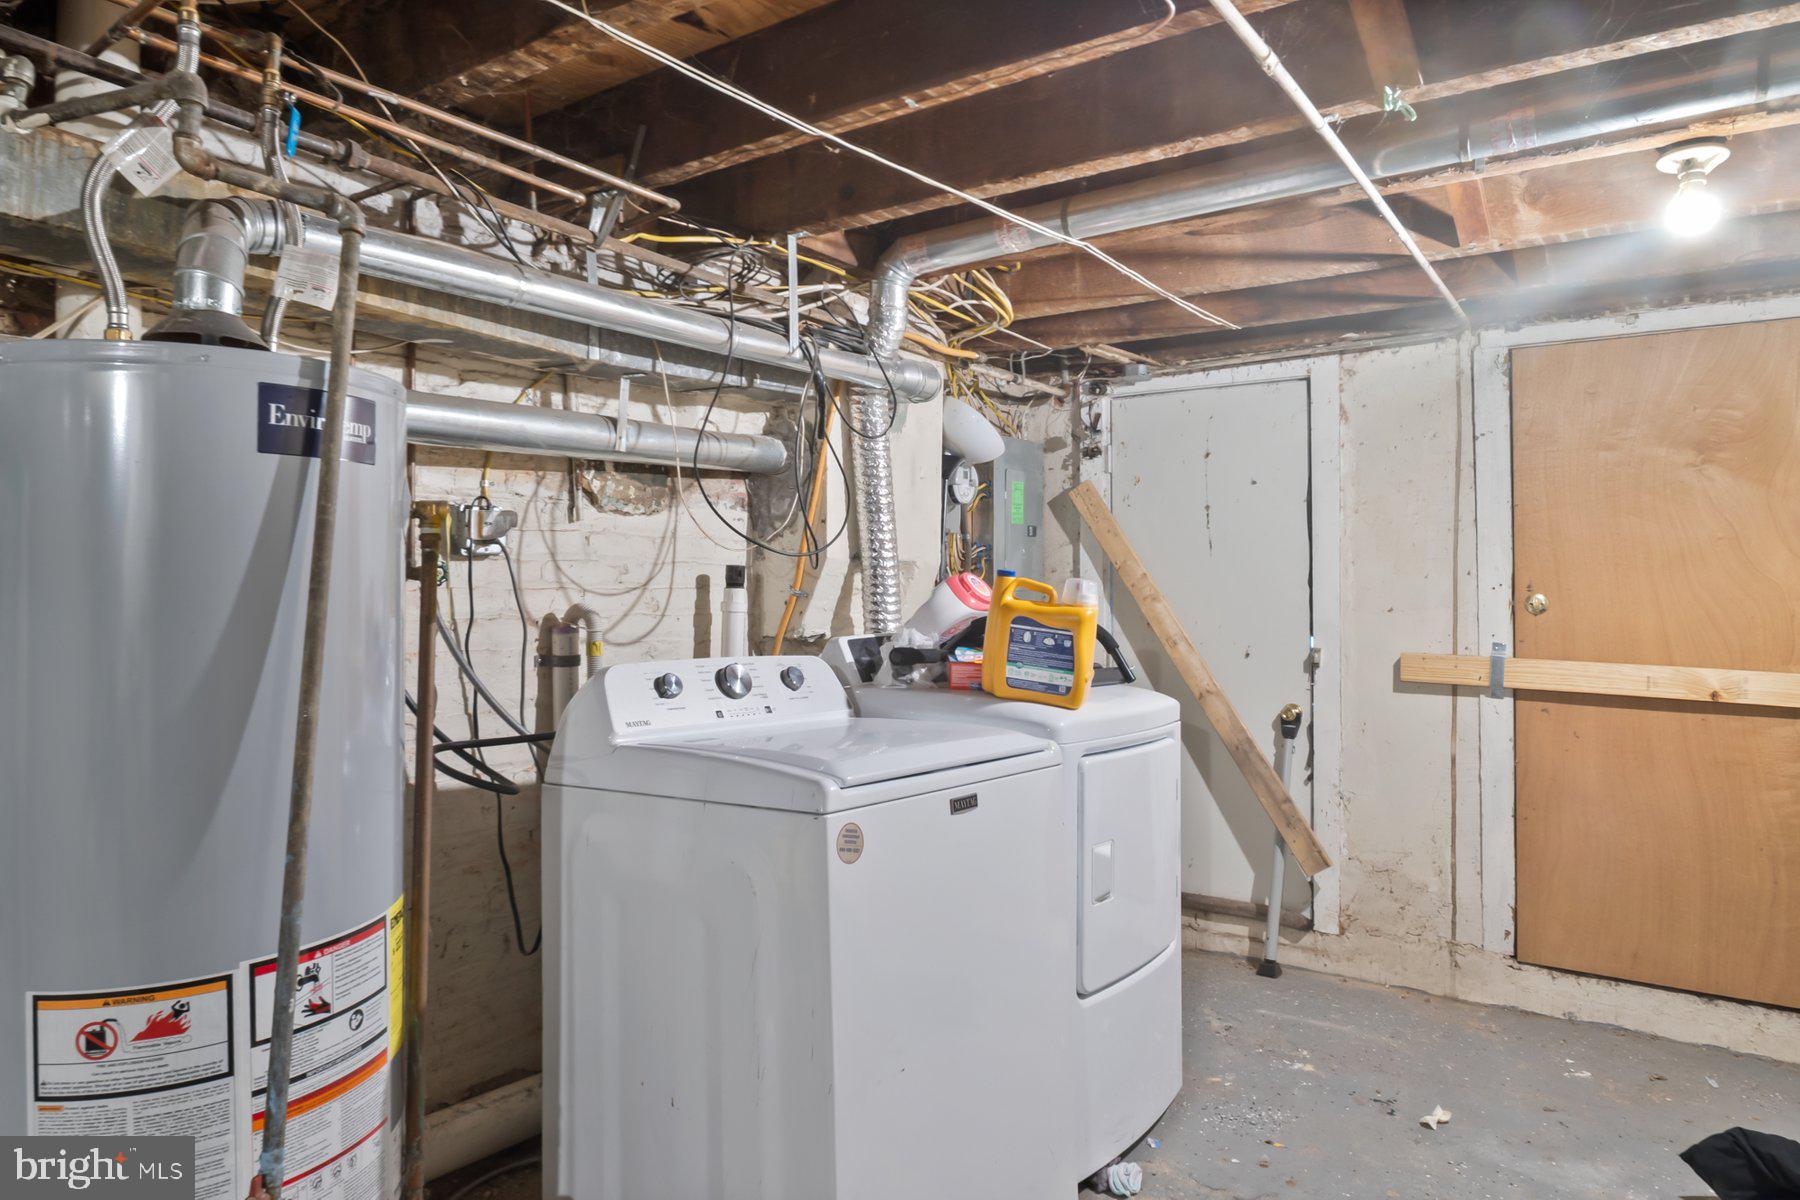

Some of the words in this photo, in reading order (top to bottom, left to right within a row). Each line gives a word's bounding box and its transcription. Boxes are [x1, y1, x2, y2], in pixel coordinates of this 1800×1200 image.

[625, 719, 652, 729] MAYTAG
[954, 796, 977, 809] MAYTAG
[112, 994, 156, 1006] WARNING
